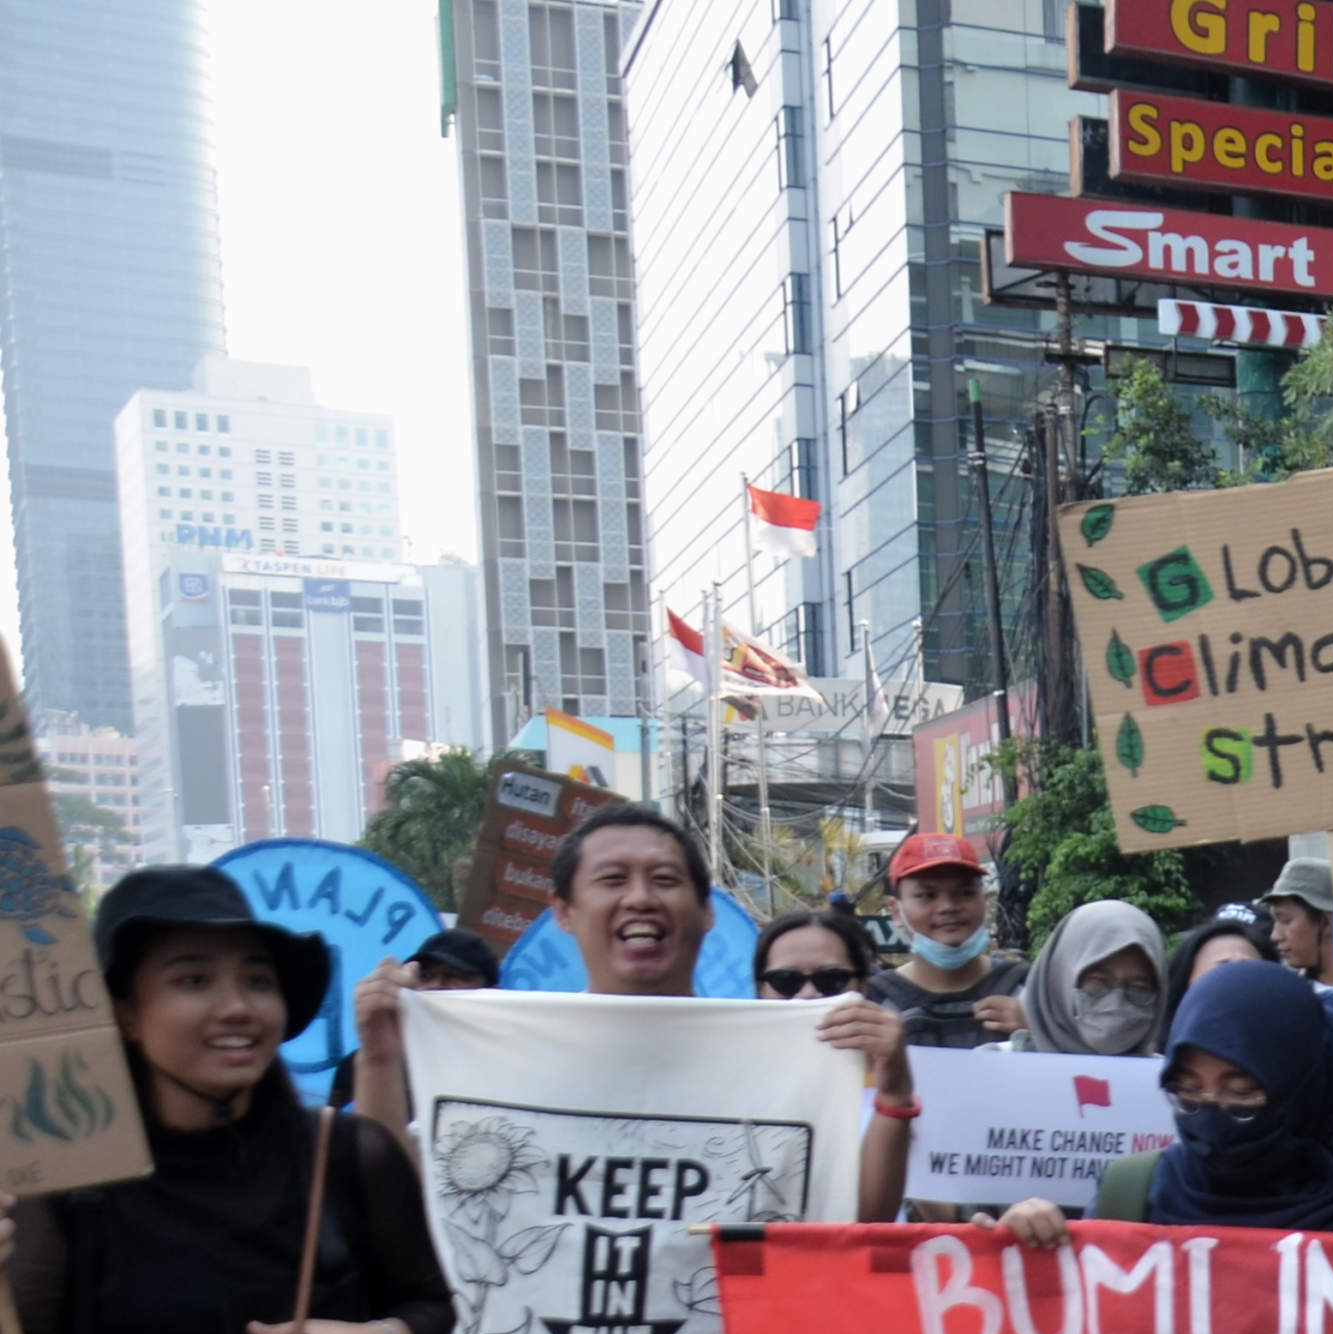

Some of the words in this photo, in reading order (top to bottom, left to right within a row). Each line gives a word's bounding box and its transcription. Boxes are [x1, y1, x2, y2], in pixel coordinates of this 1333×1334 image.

[1063, 209, 1316, 288] Smart
[176, 524, 254, 549] PNM
[255, 558, 312, 575] TASPEN
[776, 692, 860, 720] BANK
[893, 695, 945, 722] EGA
[501, 779, 549, 806] Hutan
[0, 948, 97, 1020] stic
[986, 1127, 1044, 1151] MAKE
[1050, 1129, 1126, 1154] CHANGE
[930, 1151, 957, 1175] WE
[962, 1154, 1027, 1179] MIGHT
[1030, 1156, 1068, 1179] NOT
[554, 1152, 710, 1222] KEEP
[592, 1235, 641, 1277] IT
[591, 1279, 636, 1317] IN
